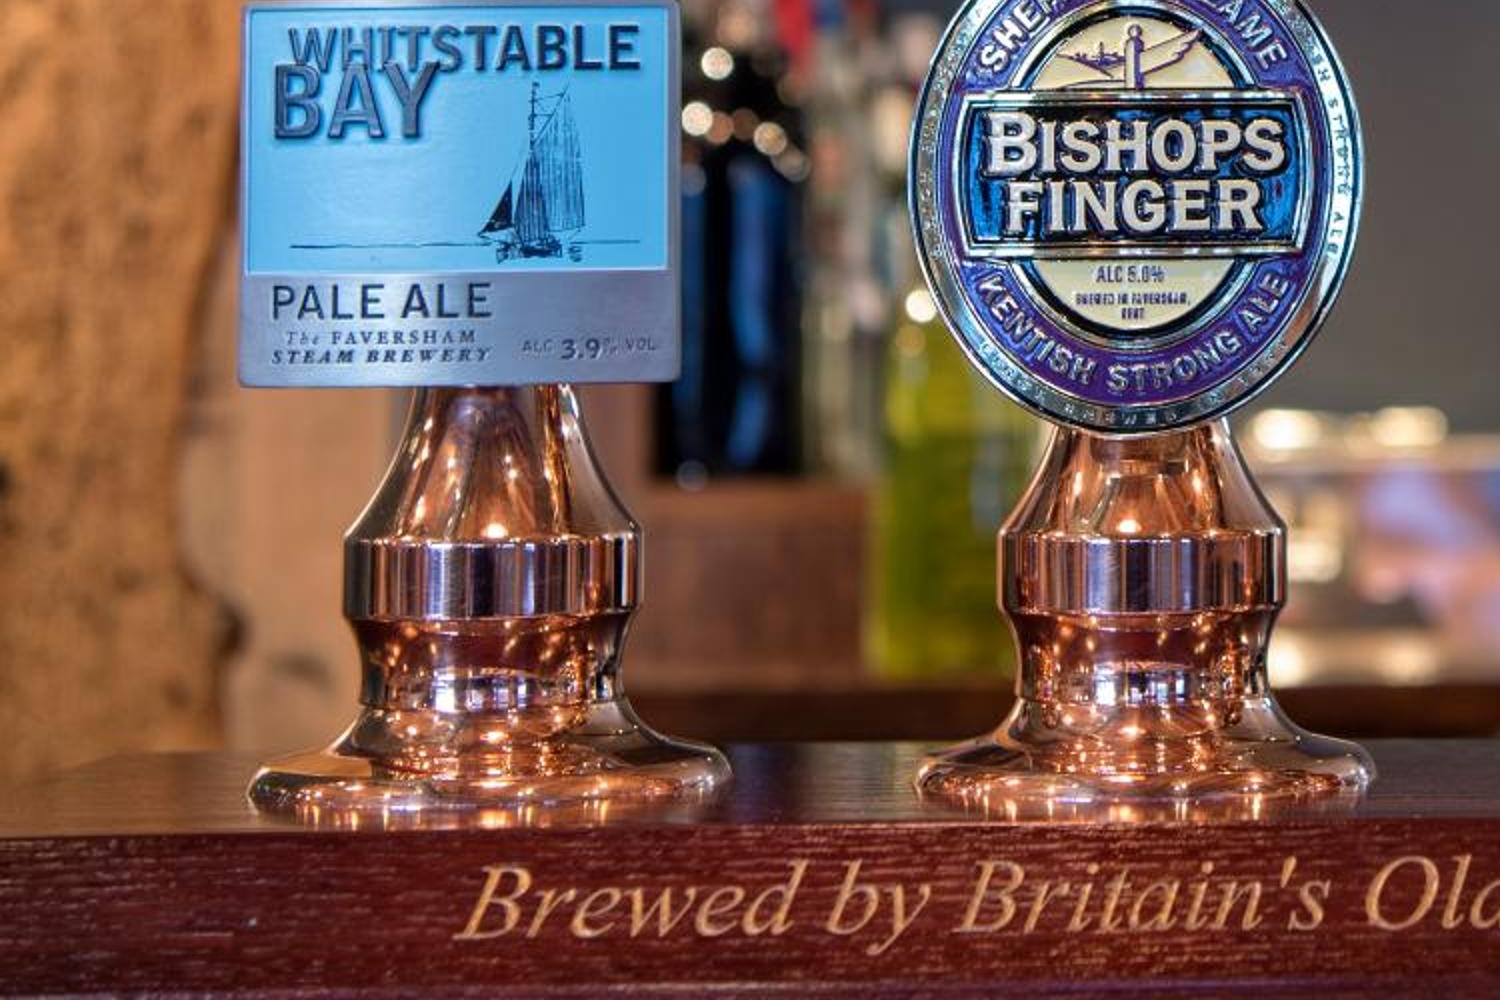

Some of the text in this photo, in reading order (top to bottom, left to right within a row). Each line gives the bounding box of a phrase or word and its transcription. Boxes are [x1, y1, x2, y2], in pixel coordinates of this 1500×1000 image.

[286, 24, 641, 74] WHITSTABLE
[273, 60, 440, 140] BAY
[986, 110, 1285, 178] BISHOPS
[1004, 177, 1263, 235] FINGER
[1096, 265, 1122, 282] ALC
[272, 281, 492, 321] PALE ALE
[271, 348, 493, 364] STEAM BREWERY
[285, 330, 476, 346] The FAVERSHAM
[522, 339, 553, 353] ALC
[625, 337, 657, 351] VOL
[977, 275, 1097, 385] KENTISH
[1107, 329, 1241, 392] STRONG
[1238, 272, 1291, 330] ALE
[453, 860, 806, 941] Brewed
[826, 860, 931, 956] by
[954, 856, 1331, 936] Britain's
